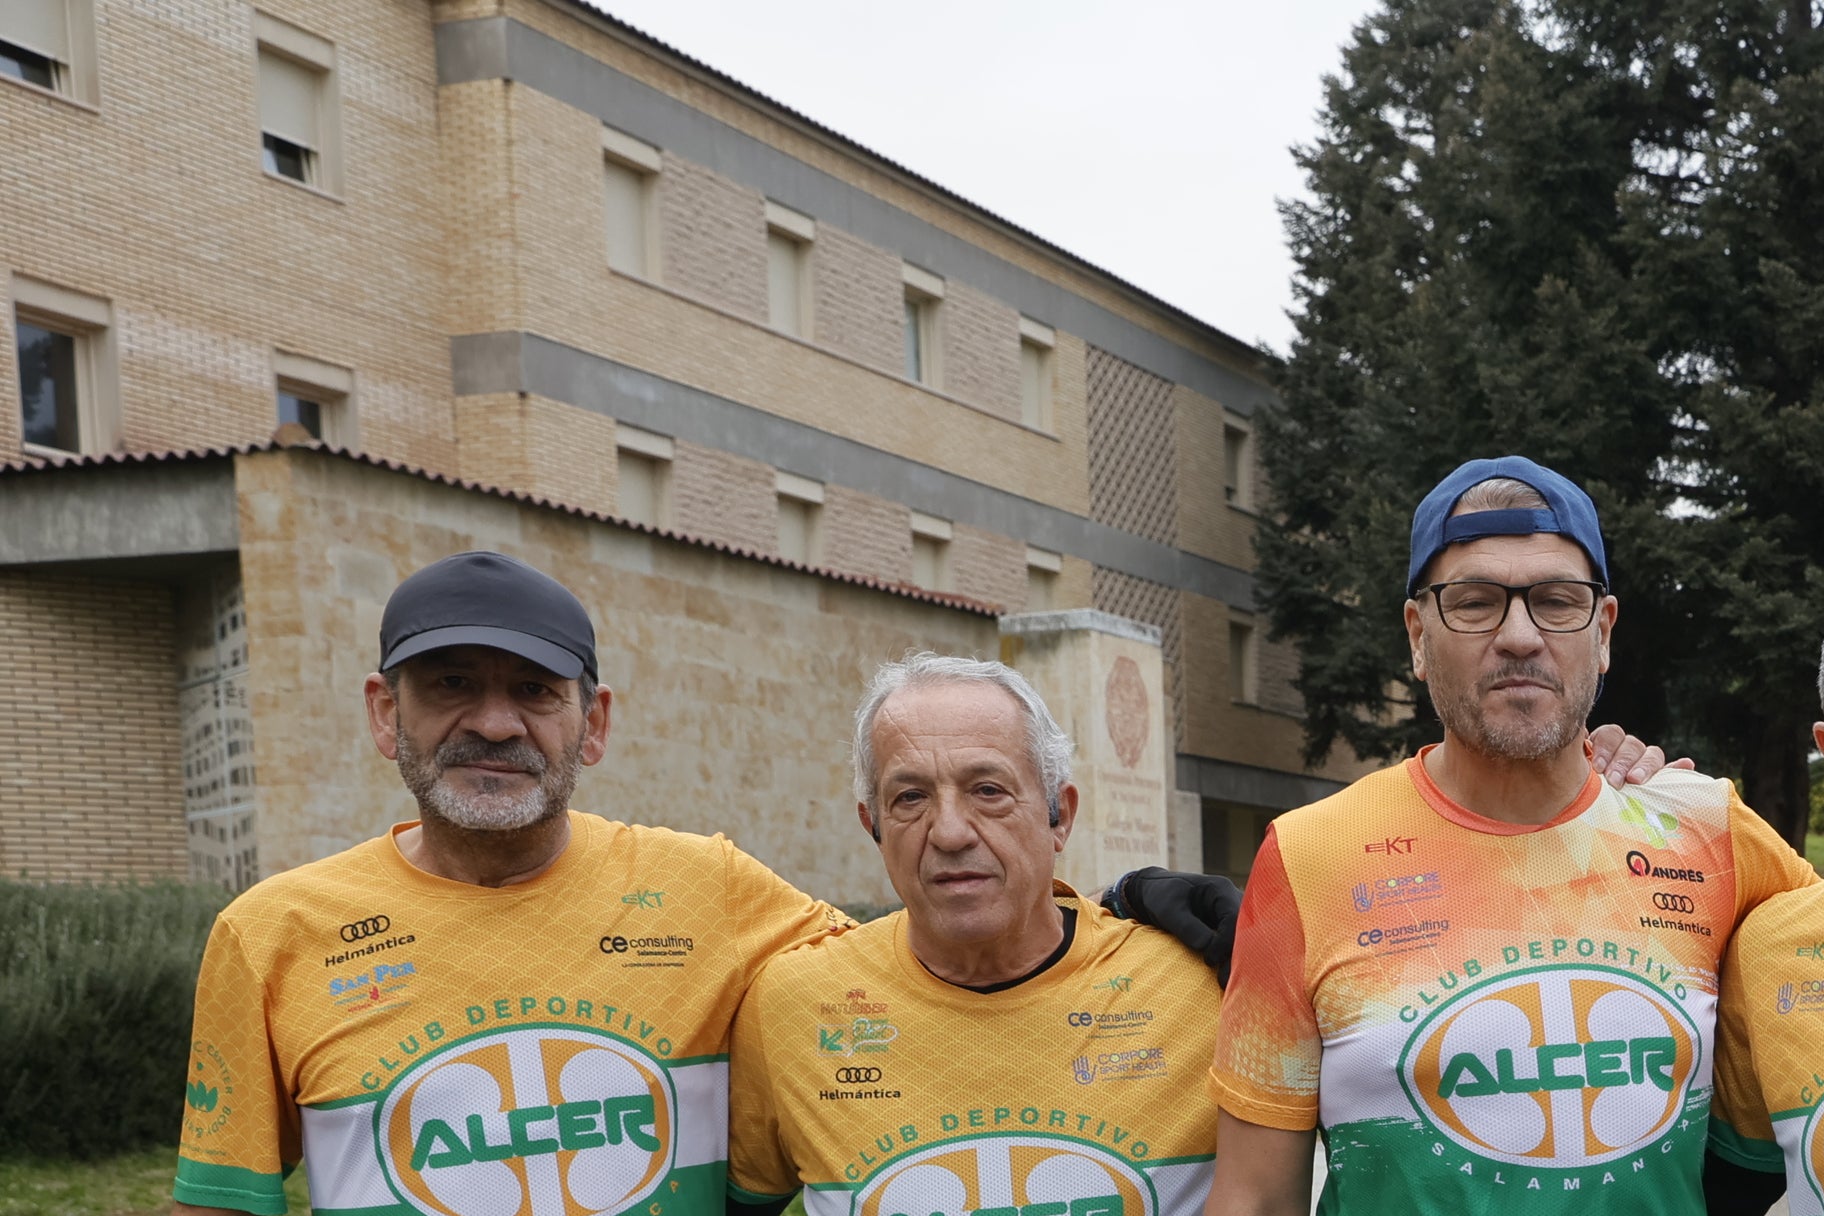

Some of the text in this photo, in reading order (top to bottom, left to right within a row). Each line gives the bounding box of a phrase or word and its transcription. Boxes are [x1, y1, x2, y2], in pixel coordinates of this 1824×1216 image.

[1364, 836, 1418, 855] EKT
[1651, 866, 1705, 883] ANDRÉS
[1384, 919, 1449, 938] consulting
[1640, 916, 1712, 936] Helmántica
[325, 934, 416, 968] Helmántica
[629, 935, 694, 951] consulting
[1400, 938, 1687, 1023] CLUB DEPORTIVO
[1094, 1010, 1154, 1022] consulting
[361, 1021, 446, 1091] CLUB
[465, 997, 673, 1056] DEPORTIVO
[1098, 1048, 1164, 1064] CORPORE
[1437, 1036, 1676, 1099] ALCER
[819, 1088, 901, 1101] Helmántica
[410, 1094, 661, 1171] ALCER
[844, 1107, 1149, 1181] CLUB DEPORTIVO
[1431, 1118, 1689, 1190] SALAMANCA
